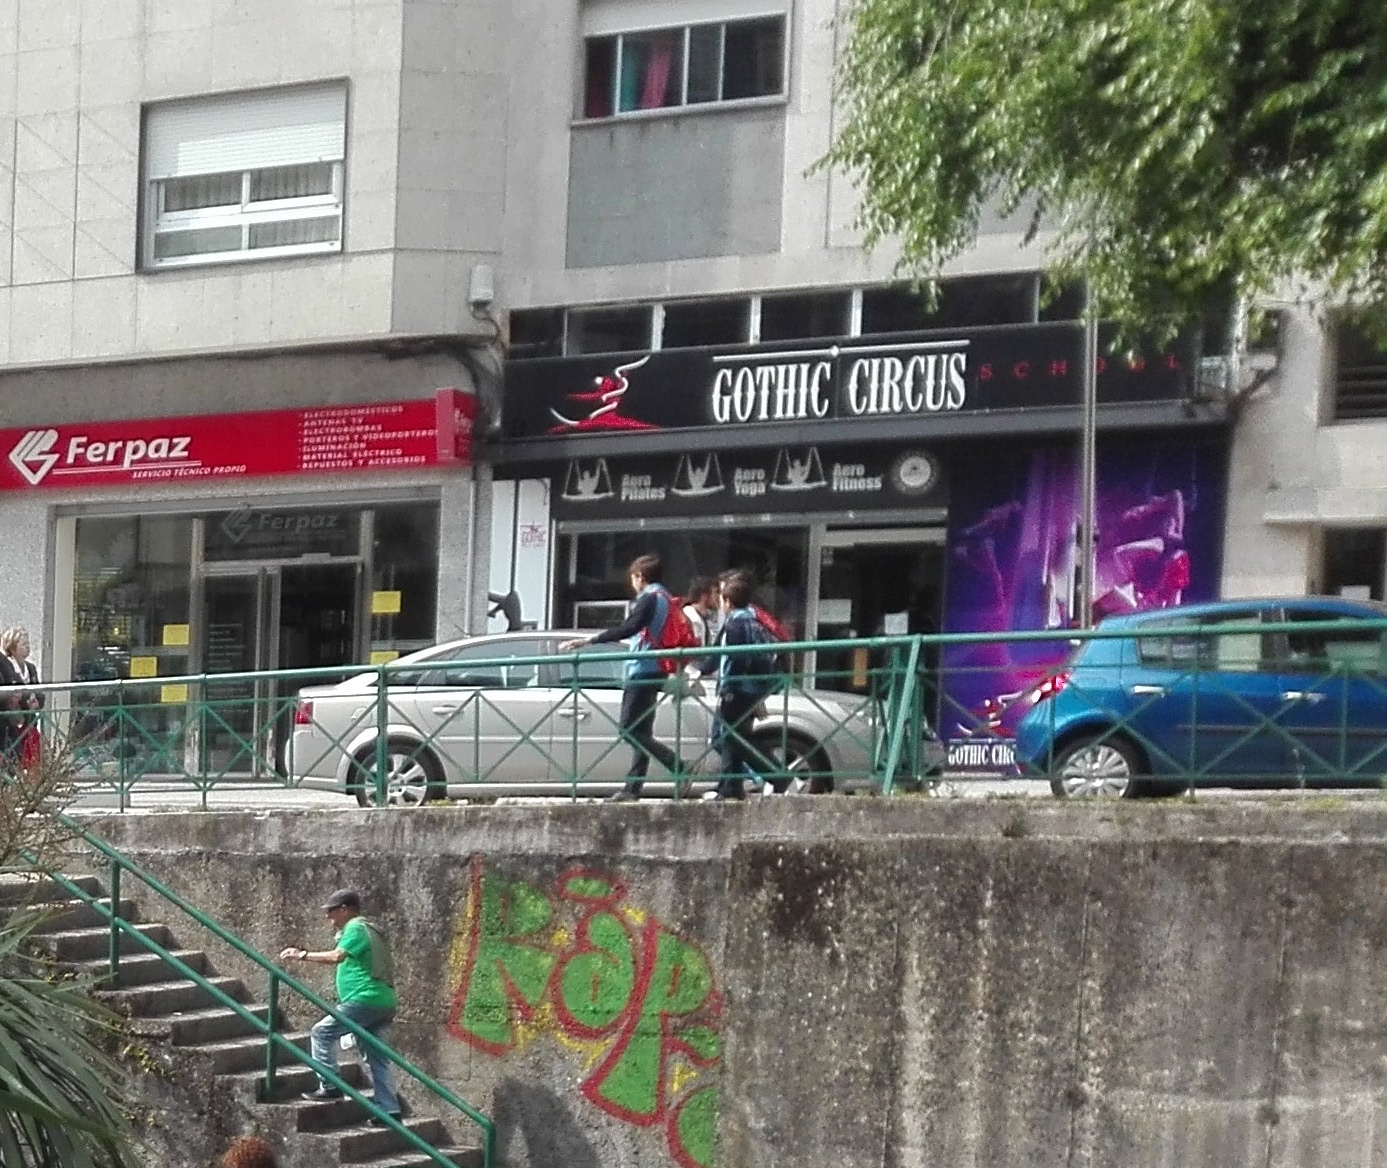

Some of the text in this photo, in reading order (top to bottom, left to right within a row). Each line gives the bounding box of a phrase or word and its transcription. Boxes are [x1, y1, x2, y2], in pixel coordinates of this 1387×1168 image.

[712, 353, 967, 424] GOTHIC CIRCUS
[303, 434, 350, 444] PORTEROS
[65, 435, 192, 468] Ferpaz
[303, 451, 348, 461] MATERIAL
[302, 455, 427, 469] REPUESTOS Y ACCESORIOS
[833, 462, 865, 476] Aero
[132, 469, 172, 479] SERVICIO
[213, 464, 247, 474] PROPIO
[734, 468, 766, 480] Aero
[735, 480, 766, 496] Yoga
[833, 476, 882, 491] Fitness
[621, 486, 666, 500] Pilates
[948, 744, 989, 766] GOTHIC
